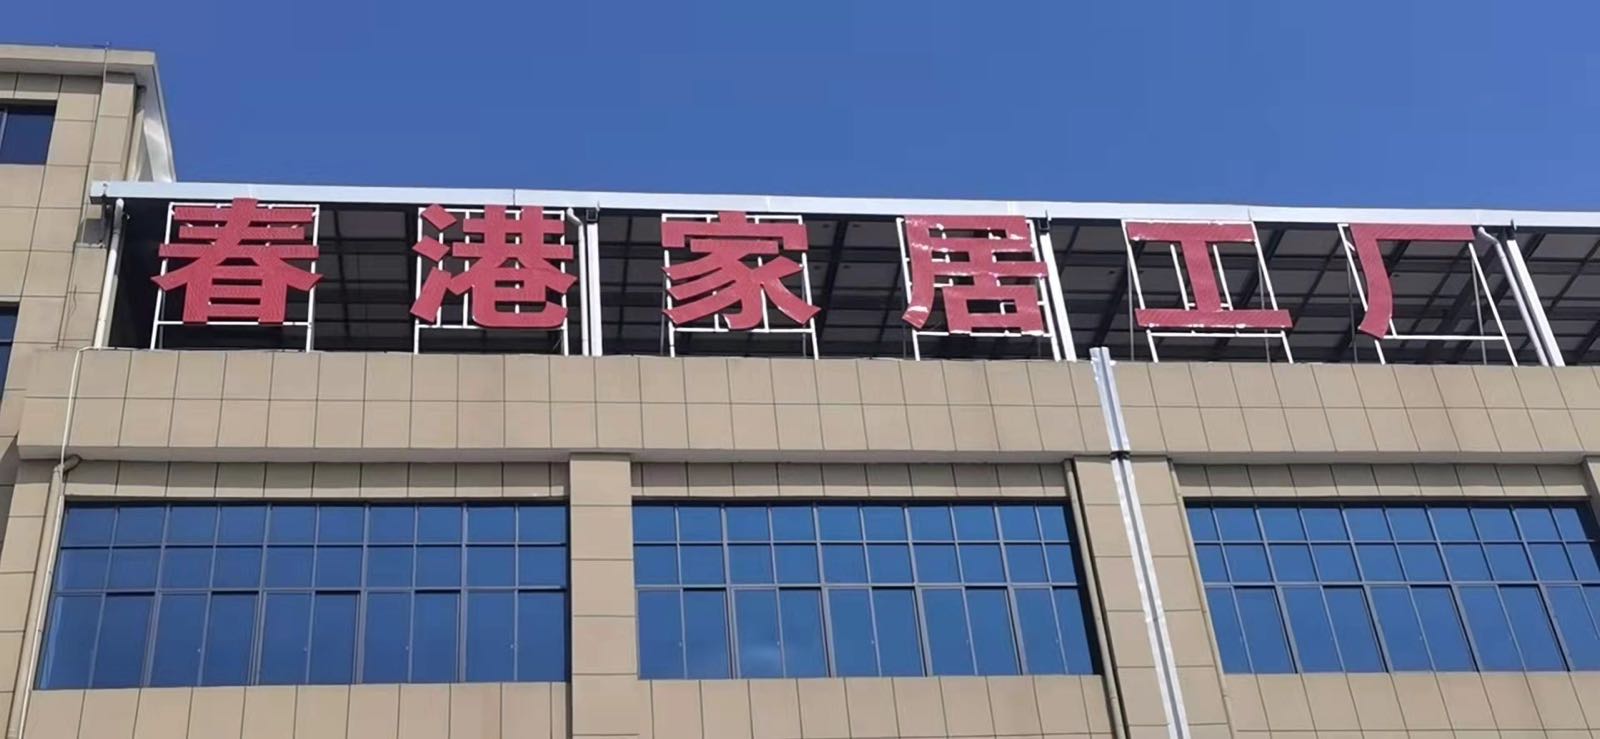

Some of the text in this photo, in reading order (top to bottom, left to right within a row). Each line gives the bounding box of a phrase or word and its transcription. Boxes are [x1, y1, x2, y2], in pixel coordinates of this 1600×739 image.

[152, 198, 1475, 340] 春港家居工厂
